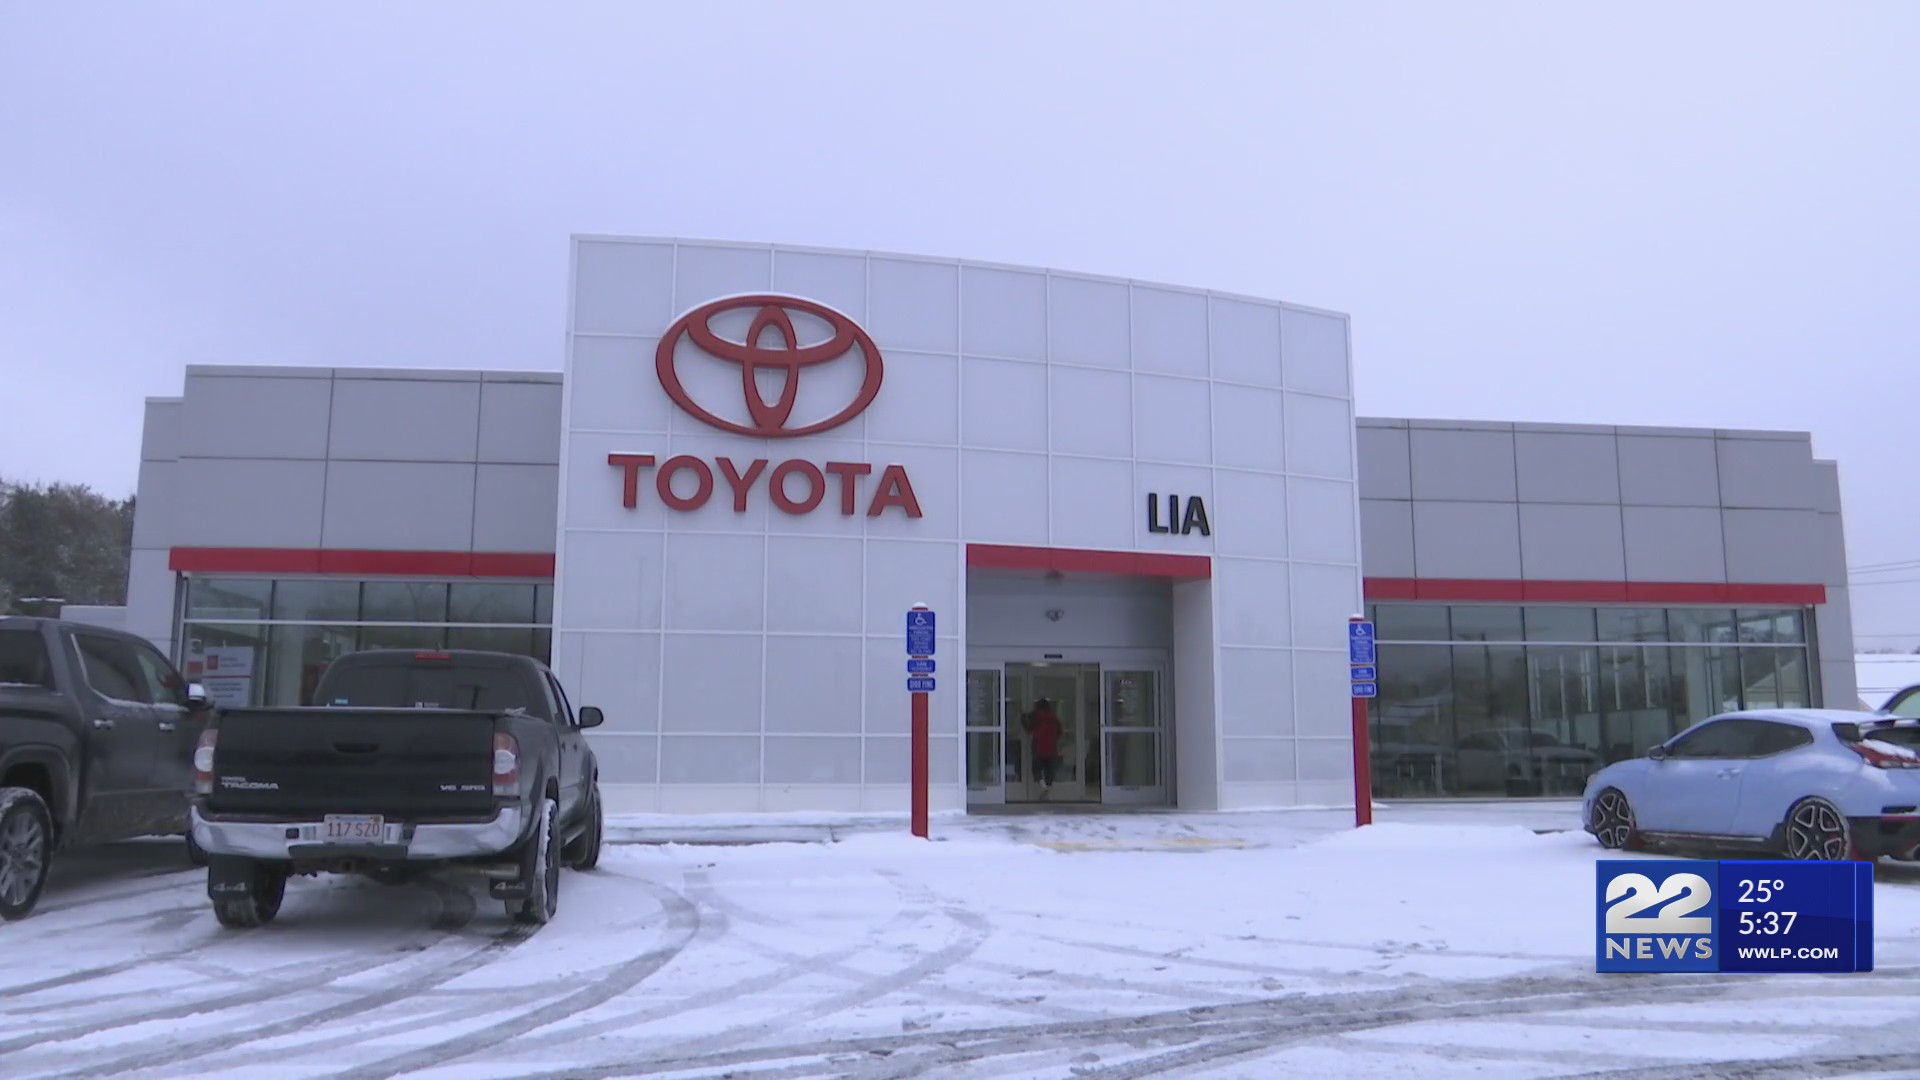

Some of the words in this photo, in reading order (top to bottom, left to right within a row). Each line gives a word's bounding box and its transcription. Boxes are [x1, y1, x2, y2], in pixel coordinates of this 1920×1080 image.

[608, 452, 923, 519] TOYOTA
[1147, 492, 1212, 537] LIA
[221, 782, 279, 790] TACOMA
[328, 822, 352, 837] 117
